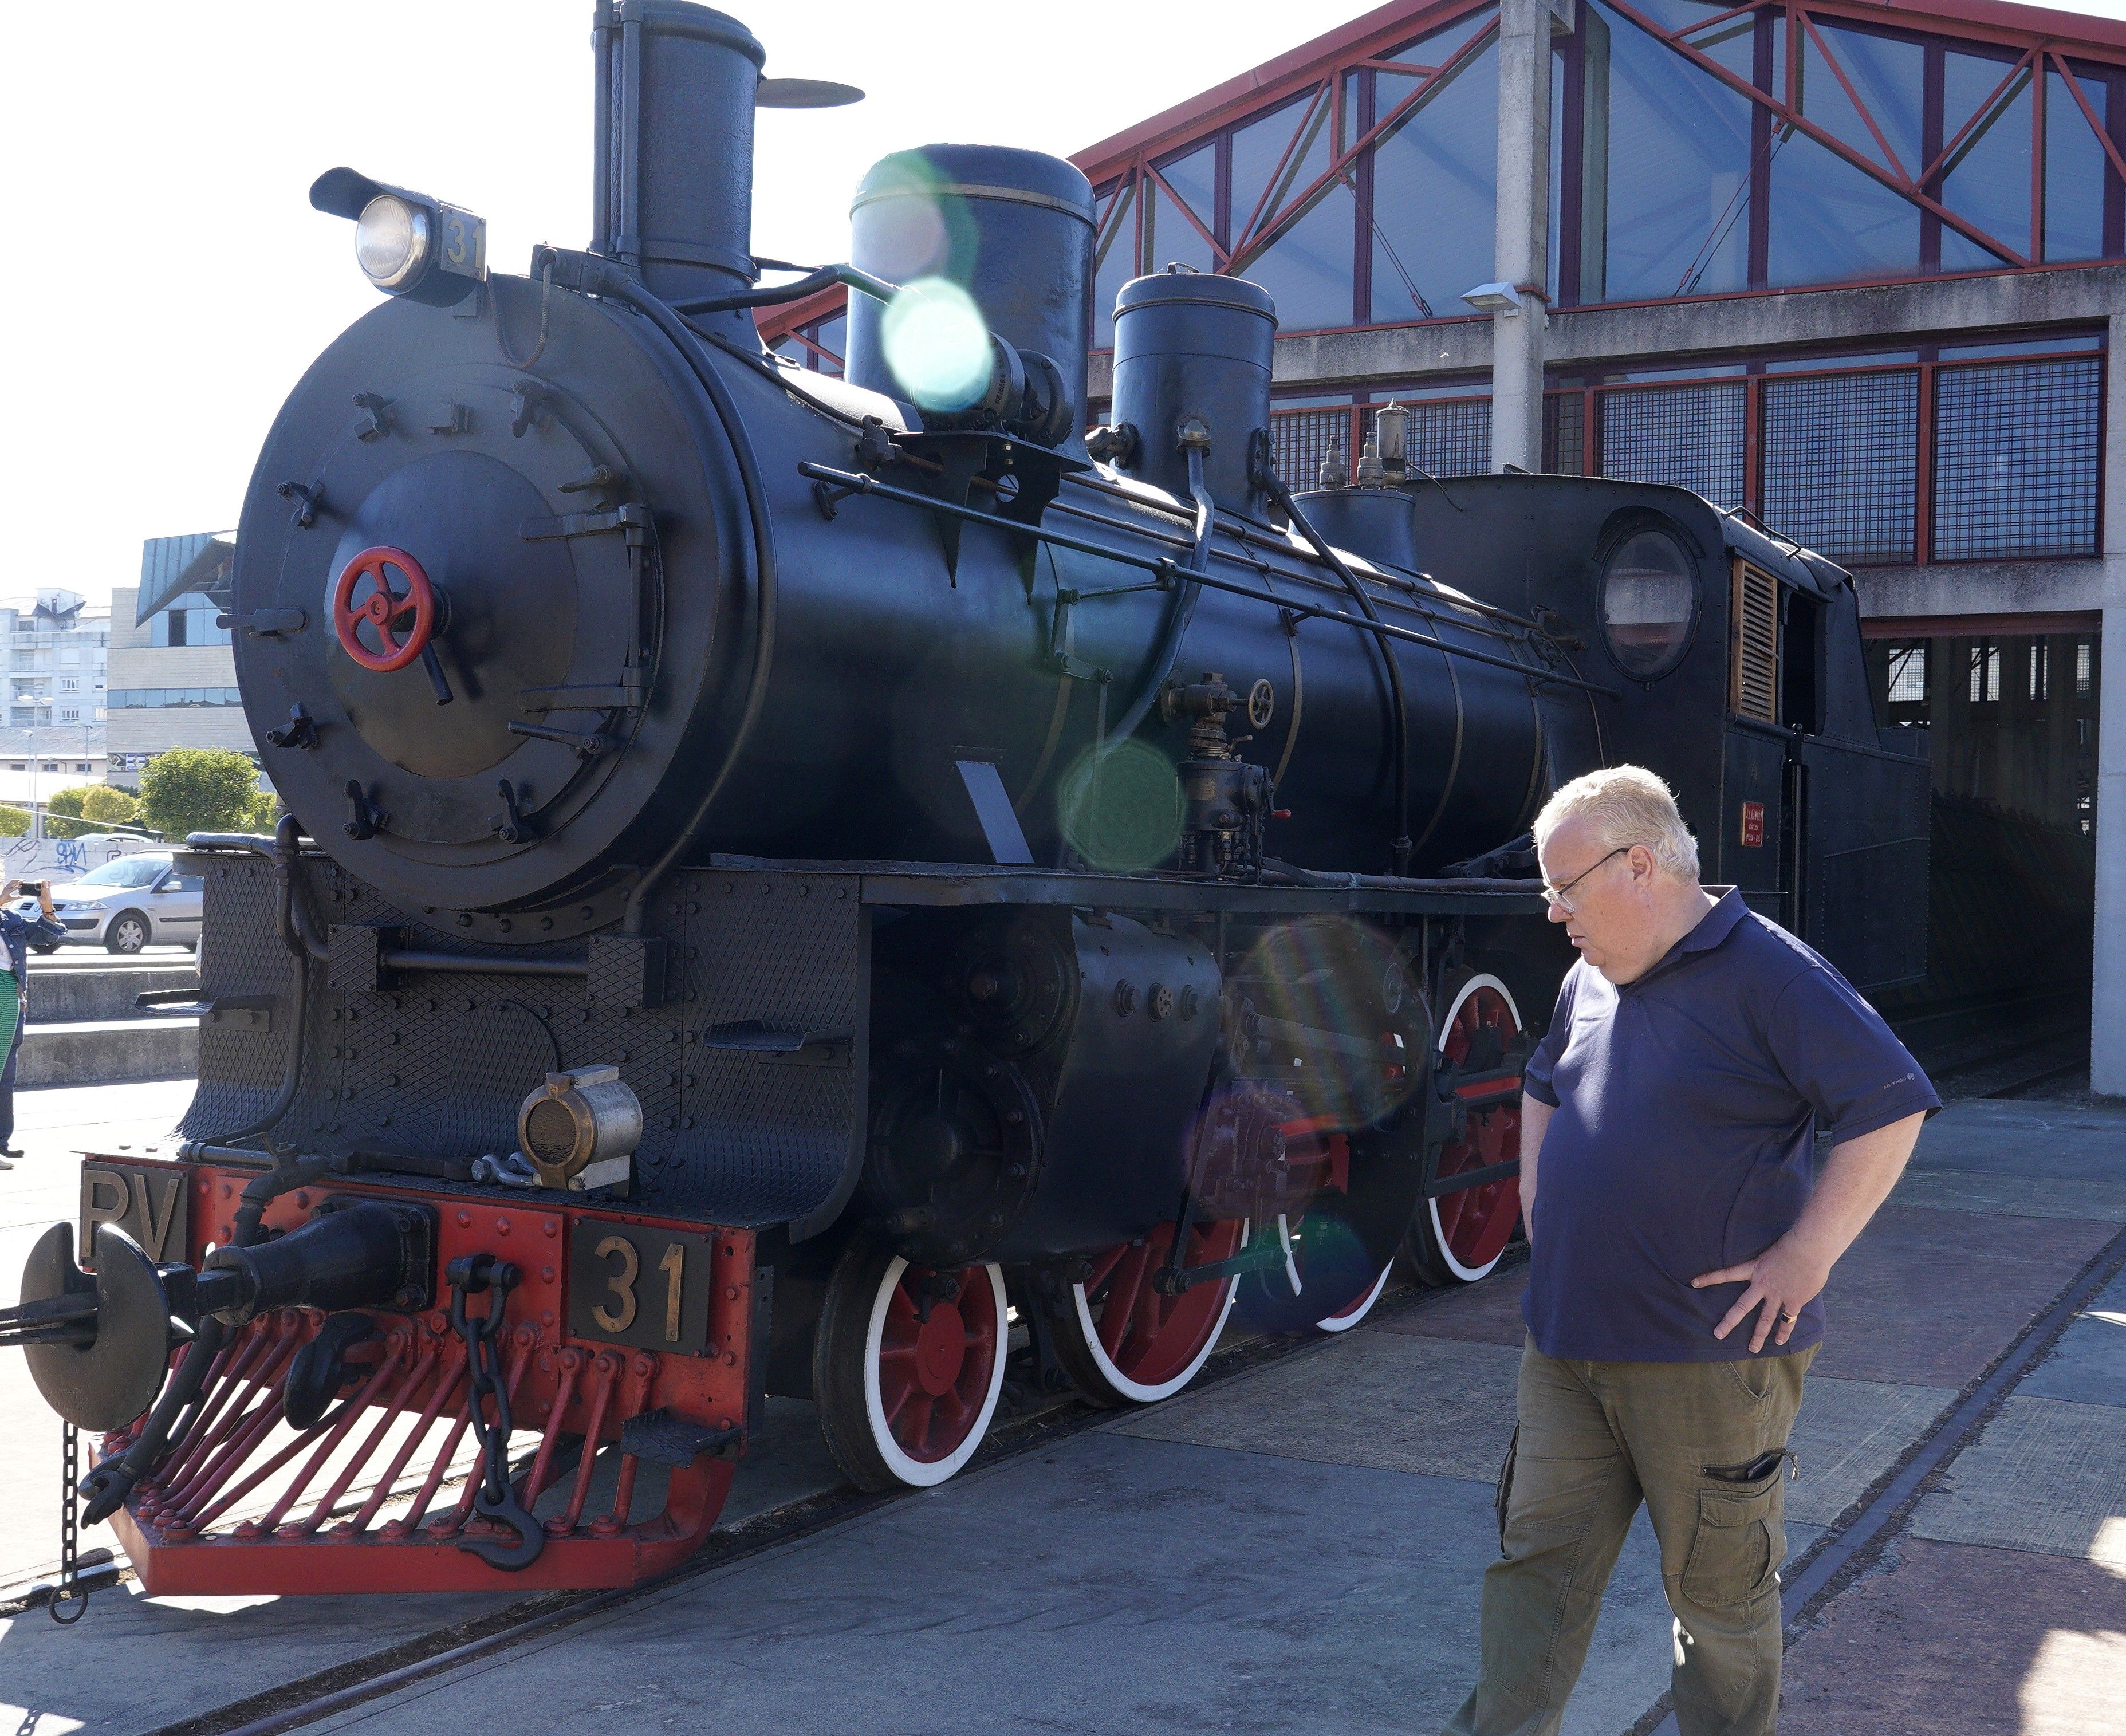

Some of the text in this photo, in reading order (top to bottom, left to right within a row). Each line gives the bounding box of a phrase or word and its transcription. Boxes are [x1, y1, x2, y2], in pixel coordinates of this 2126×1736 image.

[448, 219, 482, 268] 31
[81, 1170, 179, 1262] PV
[592, 1236, 684, 1341] 31
